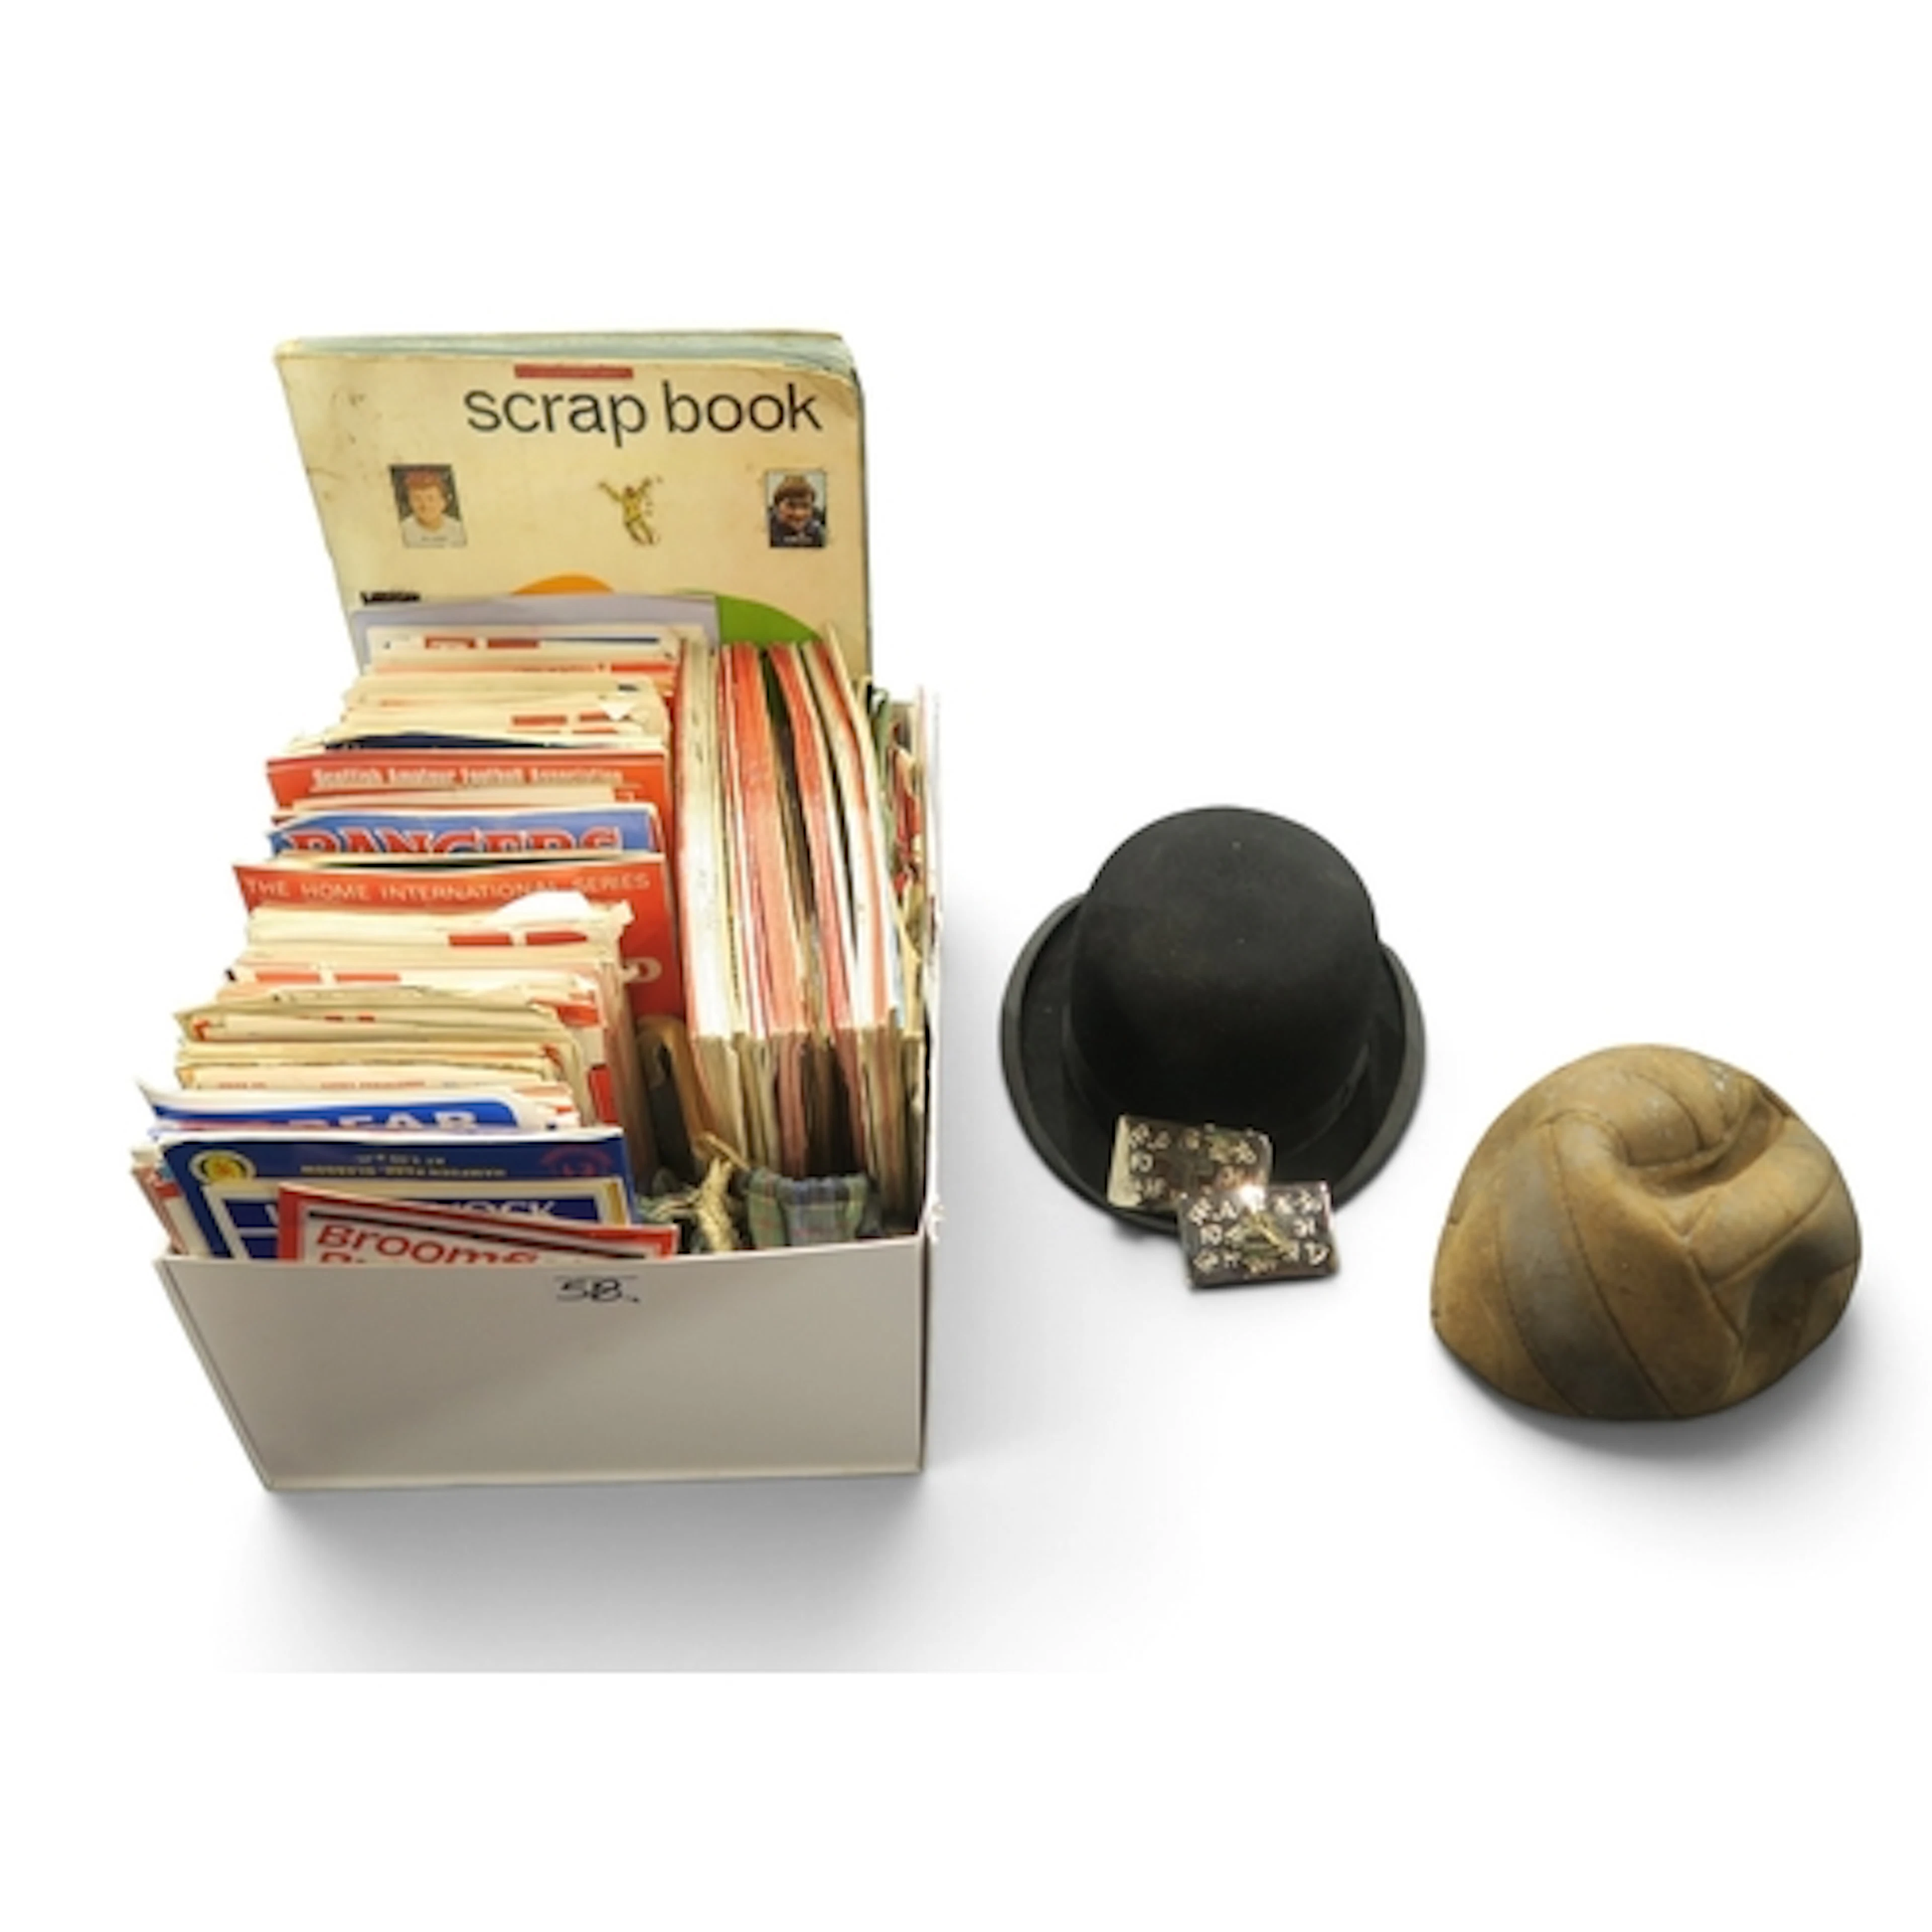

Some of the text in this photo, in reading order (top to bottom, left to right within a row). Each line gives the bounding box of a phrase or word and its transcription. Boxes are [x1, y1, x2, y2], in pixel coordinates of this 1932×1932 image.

[463, 379, 822, 448] scrap book
[244, 876, 290, 898] THE
[301, 881, 373, 901] HOME
[571, 872, 651, 893] SERIES
